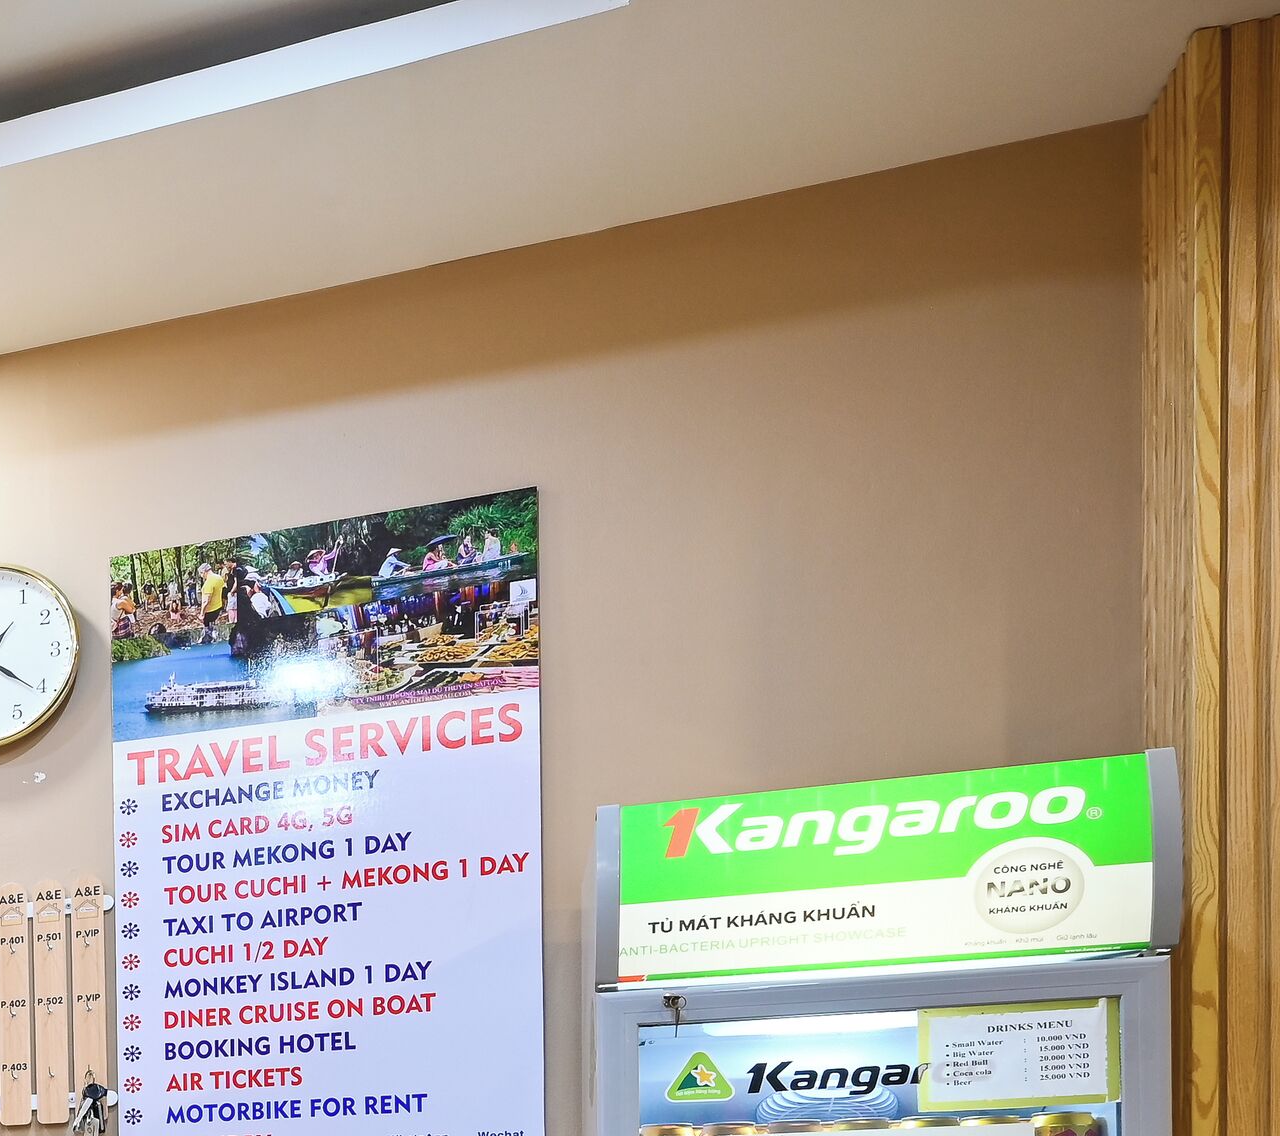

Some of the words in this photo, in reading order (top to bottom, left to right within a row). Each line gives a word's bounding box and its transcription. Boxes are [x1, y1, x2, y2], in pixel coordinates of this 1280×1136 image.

[18, 588, 28, 605] 1
[39, 609, 51, 626] 2
[50, 640, 61, 658] 3
[36, 678, 48, 694] 4
[12, 704, 23, 721] 5
[127, 734, 291, 786] TRAVEL
[304, 702, 524, 767] SERVICES
[161, 780, 284, 813] EXCHANGE
[292, 769, 380, 798] MONEY
[161, 821, 200, 845] SIM
[207, 813, 270, 838] CARD
[322, 804, 353, 827] 5G
[163, 851, 226, 875] TOUR
[232, 839, 335, 870] MEKONG
[344, 837, 354, 857] 1
[364, 832, 412, 856] DAY
[994, 864, 1027, 875] CÔNG
[164, 882, 227, 906] TOUR
[234, 874, 307, 901] CUCHI
[341, 860, 450, 891] MEKONG
[459, 859, 469, 879] 1
[480, 852, 530, 876] DAY
[986, 876, 1072, 898] NANO
[35, 889, 62, 901] A&E
[74, 885, 101, 897] A&E
[163, 914, 215, 937] TAXI
[221, 911, 254, 932] TO
[260, 901, 363, 930] AIRPORT
[648, 917, 673, 934] TỦ
[679, 914, 721, 932] MÁT
[727, 910, 797, 928] KHÁNG
[803, 900, 876, 923] KHUẨN
[0, 935, 25, 946] P.401
[37, 932, 62, 943] P.501
[75, 928, 100, 939] P.VIP
[619, 939, 736, 957] ANTI-BACTERIA
[738, 934, 809, 949] UPRIGHT
[813, 926, 907, 944] SHOWCASE
[163, 944, 235, 968] CUCHI
[242, 940, 276, 964] 1/2
[283, 936, 329, 960] DAY
[164, 973, 263, 999] MONKEY
[270, 967, 356, 992] ISLAND
[364, 965, 373, 984] 1
[384, 960, 433, 982] DAY
[0, 999, 27, 1009] P.402
[37, 996, 64, 1006] P.502
[76, 993, 101, 1003] P.VIP
[163, 1006, 232, 1030] DINER
[238, 1000, 320, 1026] CRUISE
[327, 998, 364, 1019] ON
[372, 993, 437, 1016] BOAT
[987, 1021, 1033, 1033] DRINKS
[1037, 1020, 1073, 1030] MENU
[164, 1036, 271, 1061] BOOKING
[279, 1031, 357, 1054] HOTEL
[978, 1039, 1003, 1047] Water
[1037, 1034, 1062, 1042] 10.000
[1065, 1032, 1086, 1040] VND
[953, 1051, 966, 1059] Big
[969, 1049, 994, 1057] Water
[1039, 1044, 1066, 1052] 15.000
[1068, 1042, 1089, 1050] VND
[1, 1062, 28, 1072] P.403
[953, 1060, 969, 1068] Red
[971, 1059, 988, 1067] Bull
[1039, 1054, 1066, 1062] 20.000
[1068, 1052, 1089, 1060] VND
[1040, 1064, 1066, 1072] 15.000
[1068, 1062, 1090, 1070] VND
[165, 1072, 204, 1093] AIR
[209, 1066, 303, 1091] TICKETS
[747, 1060, 931, 1095] Kangar
[953, 1079, 972, 1087] Beer
[1040, 1073, 1066, 1081] 25.000
[1069, 1071, 1090, 1079] VND
[166, 1099, 302, 1125] MOTORBIKE
[310, 1096, 356, 1118] FOR
[364, 1093, 428, 1116] RENT
